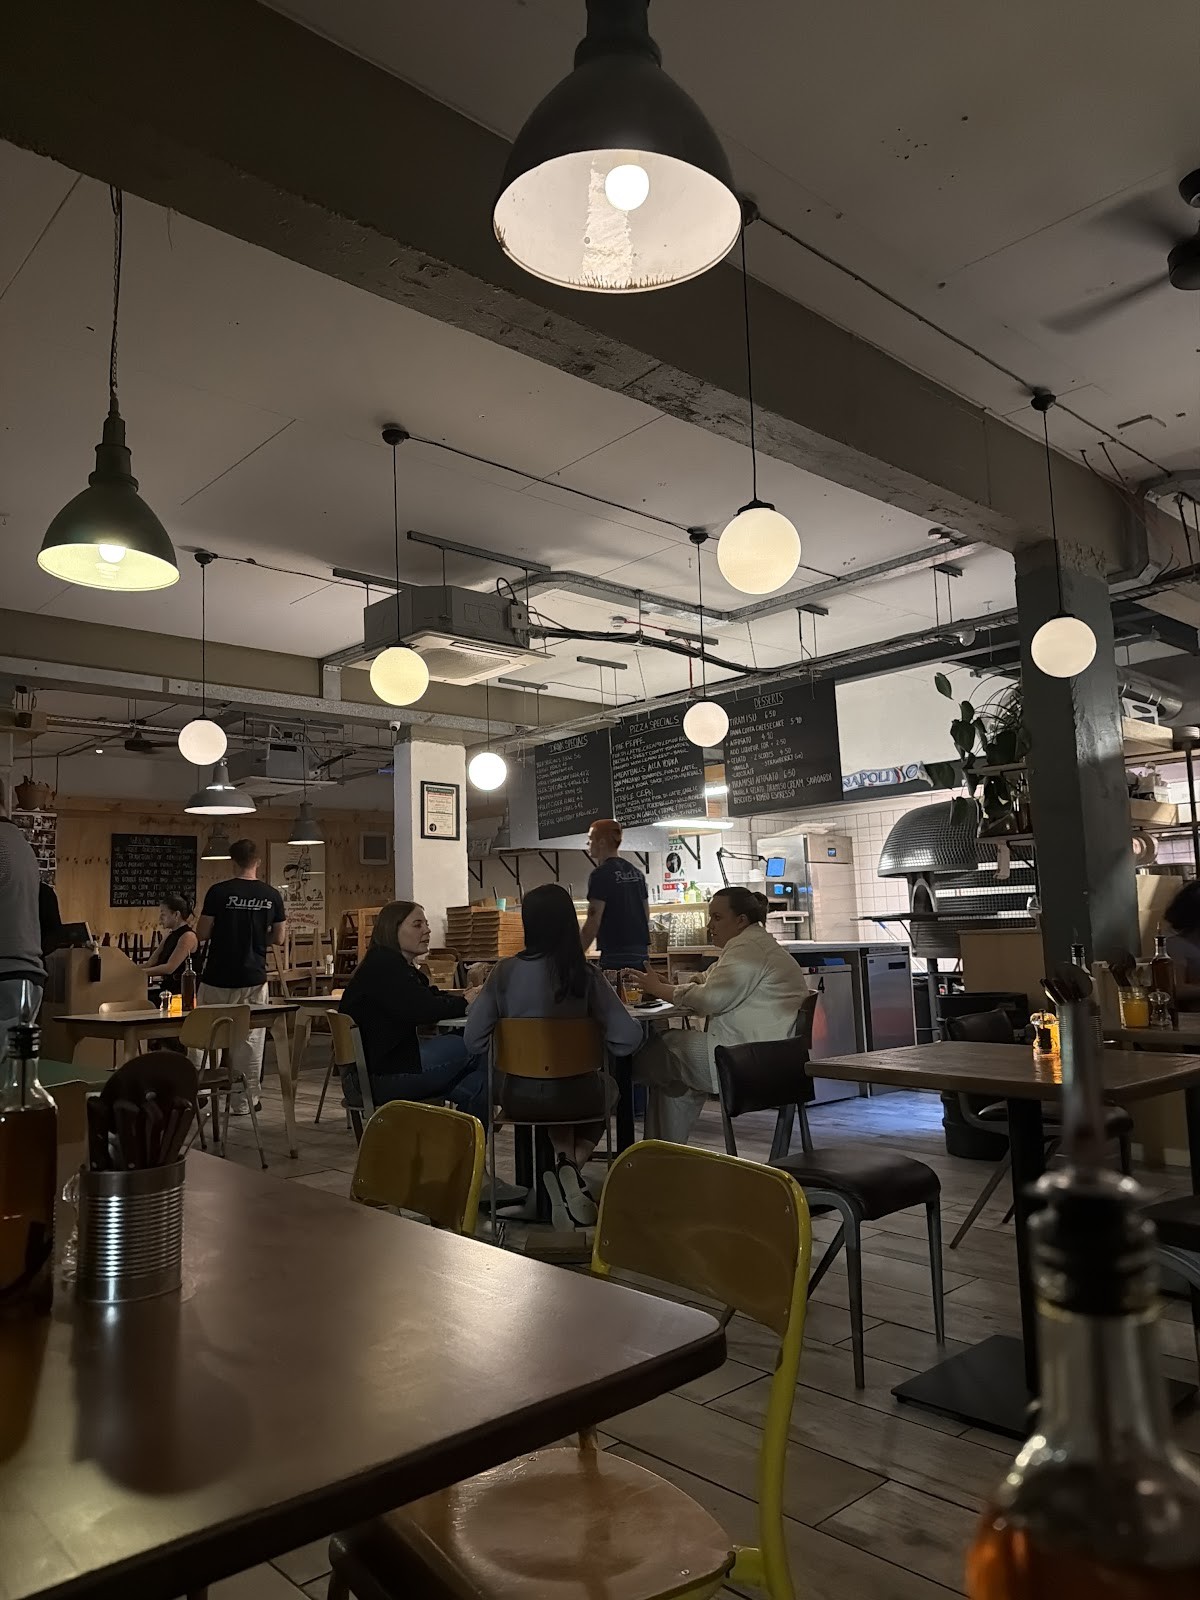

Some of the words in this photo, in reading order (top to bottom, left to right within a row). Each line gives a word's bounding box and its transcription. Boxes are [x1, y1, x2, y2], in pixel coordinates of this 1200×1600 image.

[753, 692, 784, 708] DESSERTS
[629, 722, 649, 734] PIZZA
[650, 714, 679, 730] SPECIALS
[730, 713, 757, 726] TIRAMISU
[756, 720, 785, 732] CHEESECAKE
[226, 896, 273, 909] Rudy's
